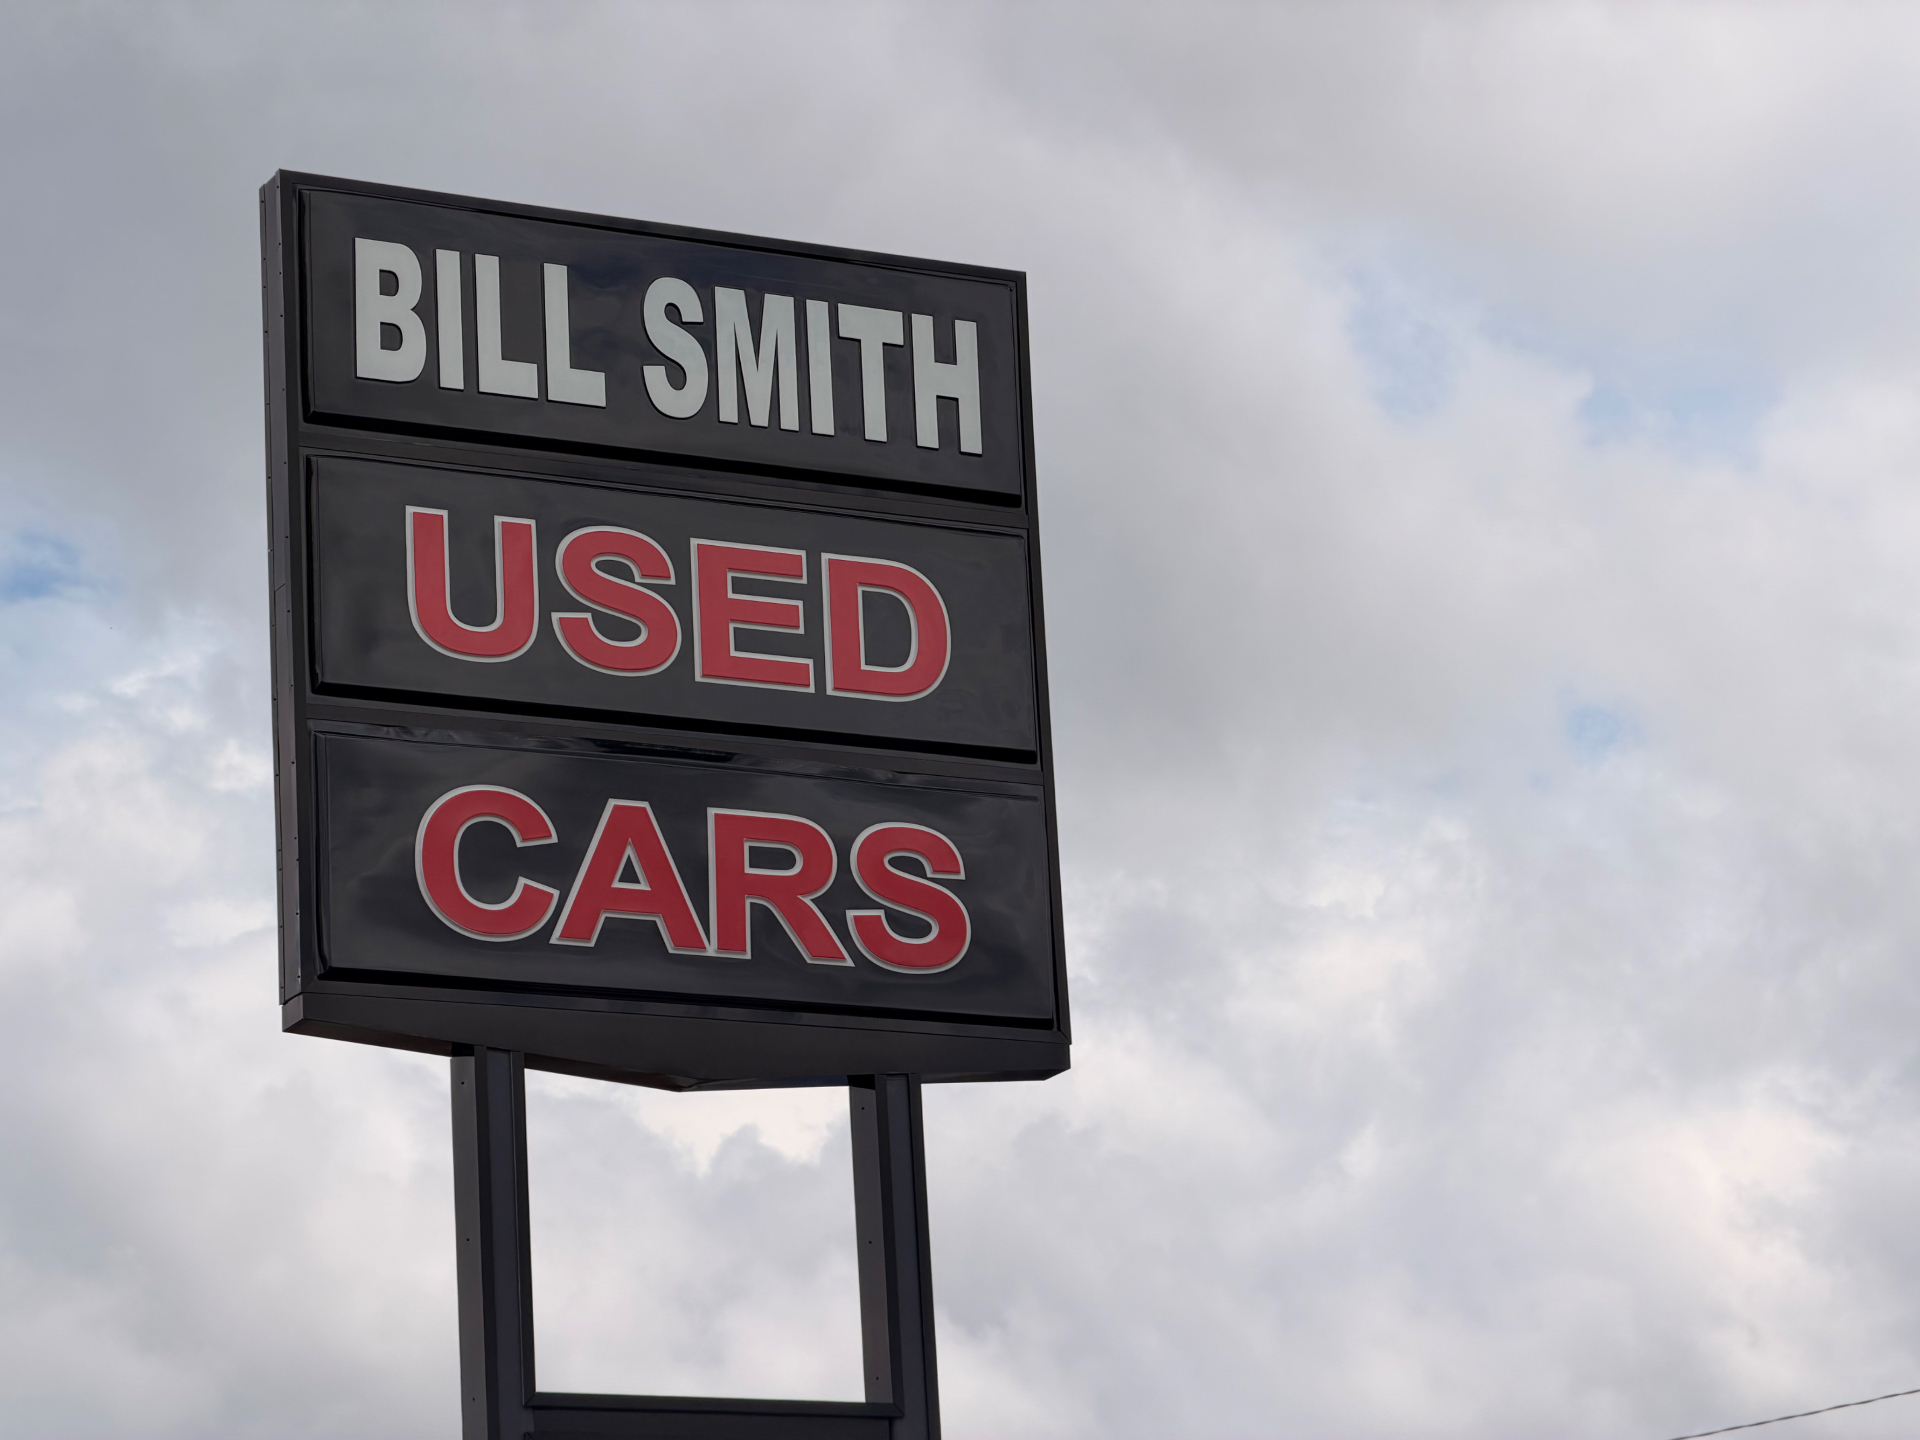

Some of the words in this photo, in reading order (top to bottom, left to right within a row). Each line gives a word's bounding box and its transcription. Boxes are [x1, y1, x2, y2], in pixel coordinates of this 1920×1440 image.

[354, 237, 607, 407] BILL
[642, 276, 983, 455] SMITH
[405, 504, 952, 703] USED
[414, 784, 972, 975] CARS
